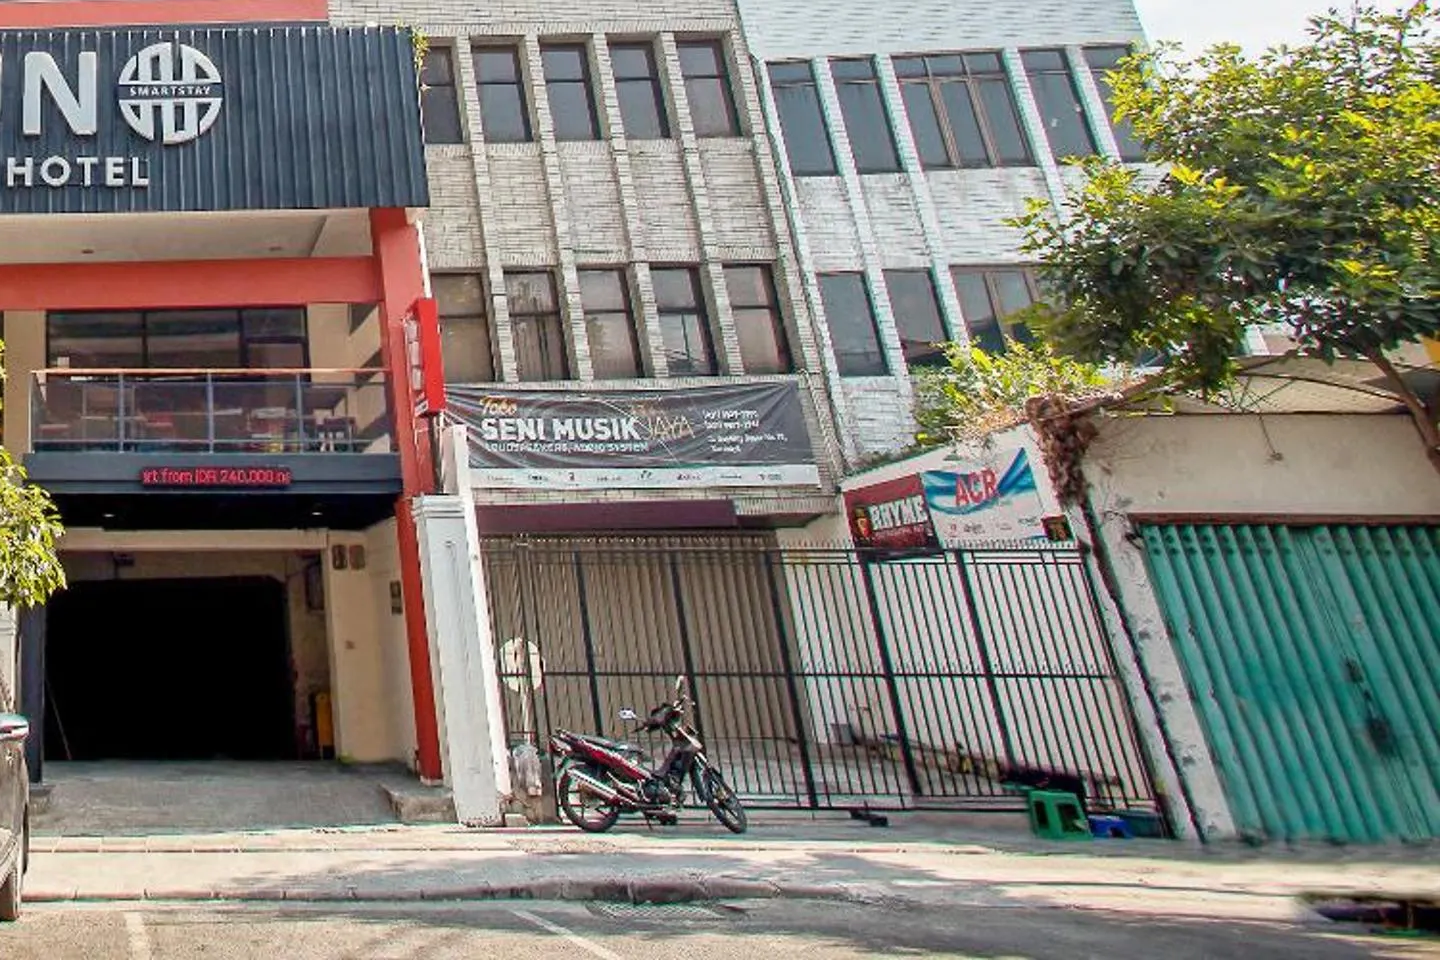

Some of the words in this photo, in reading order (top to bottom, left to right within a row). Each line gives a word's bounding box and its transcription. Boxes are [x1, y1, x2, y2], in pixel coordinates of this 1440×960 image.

[130, 86, 211, 96] SMARTSTAY
[6, 156, 150, 187] HOTEL
[480, 395, 517, 415] Toko
[481, 417, 546, 441] SENI
[553, 416, 641, 440] MUSIK
[162, 468, 193, 483] from
[956, 468, 1000, 505] ACR
[869, 495, 928, 530] RHYME
